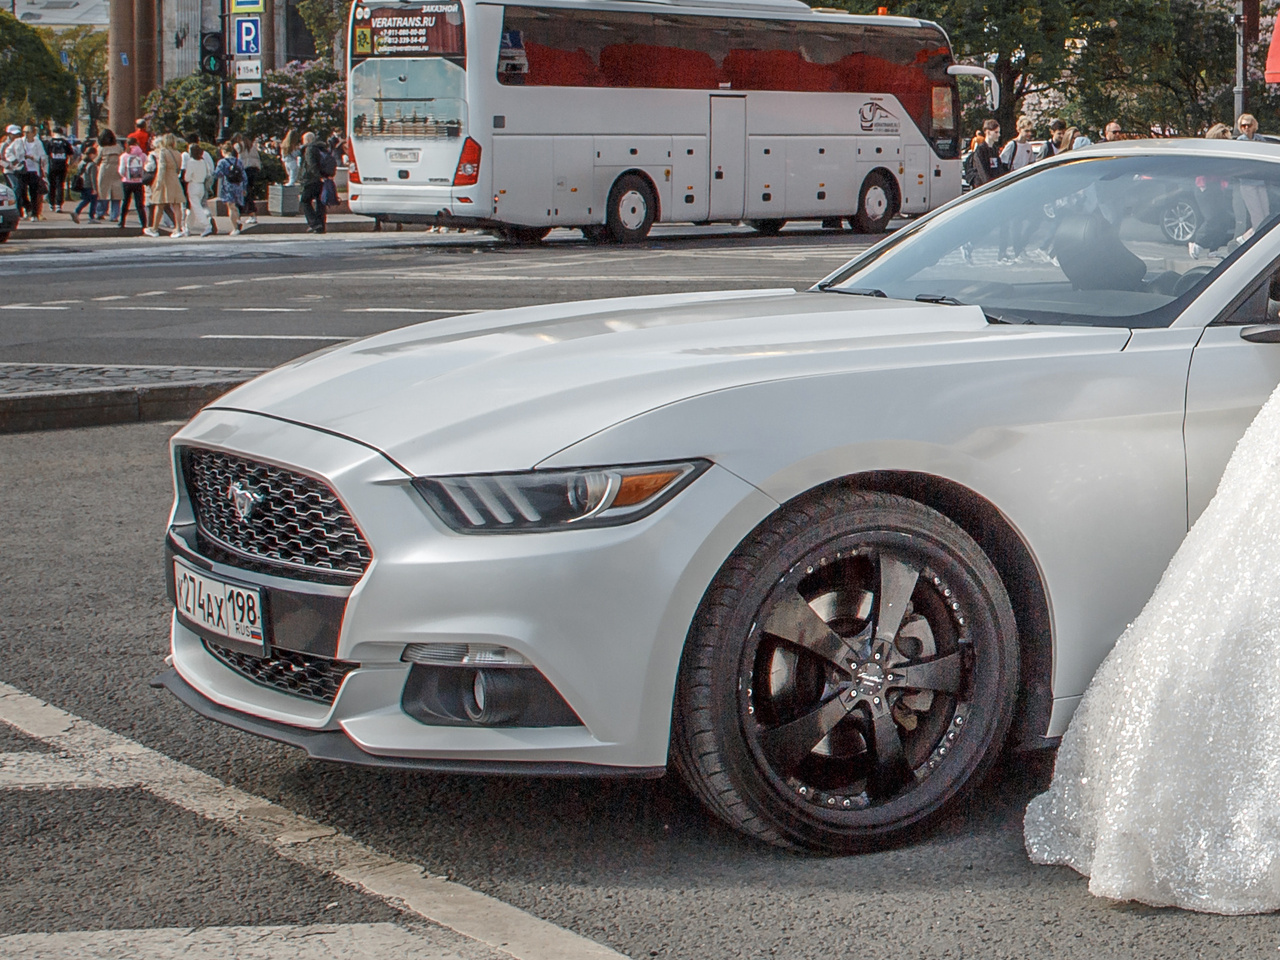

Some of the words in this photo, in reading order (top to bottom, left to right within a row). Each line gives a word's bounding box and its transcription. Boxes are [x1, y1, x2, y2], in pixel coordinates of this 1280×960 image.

[422, 4, 459, 13] ЗАКАЗНОЙ
[371, 16, 436, 28] VERATRANS.RU
[242, 22, 256, 51] P
[227, 589, 257, 626] 198
[235, 623, 251, 638] RUS
